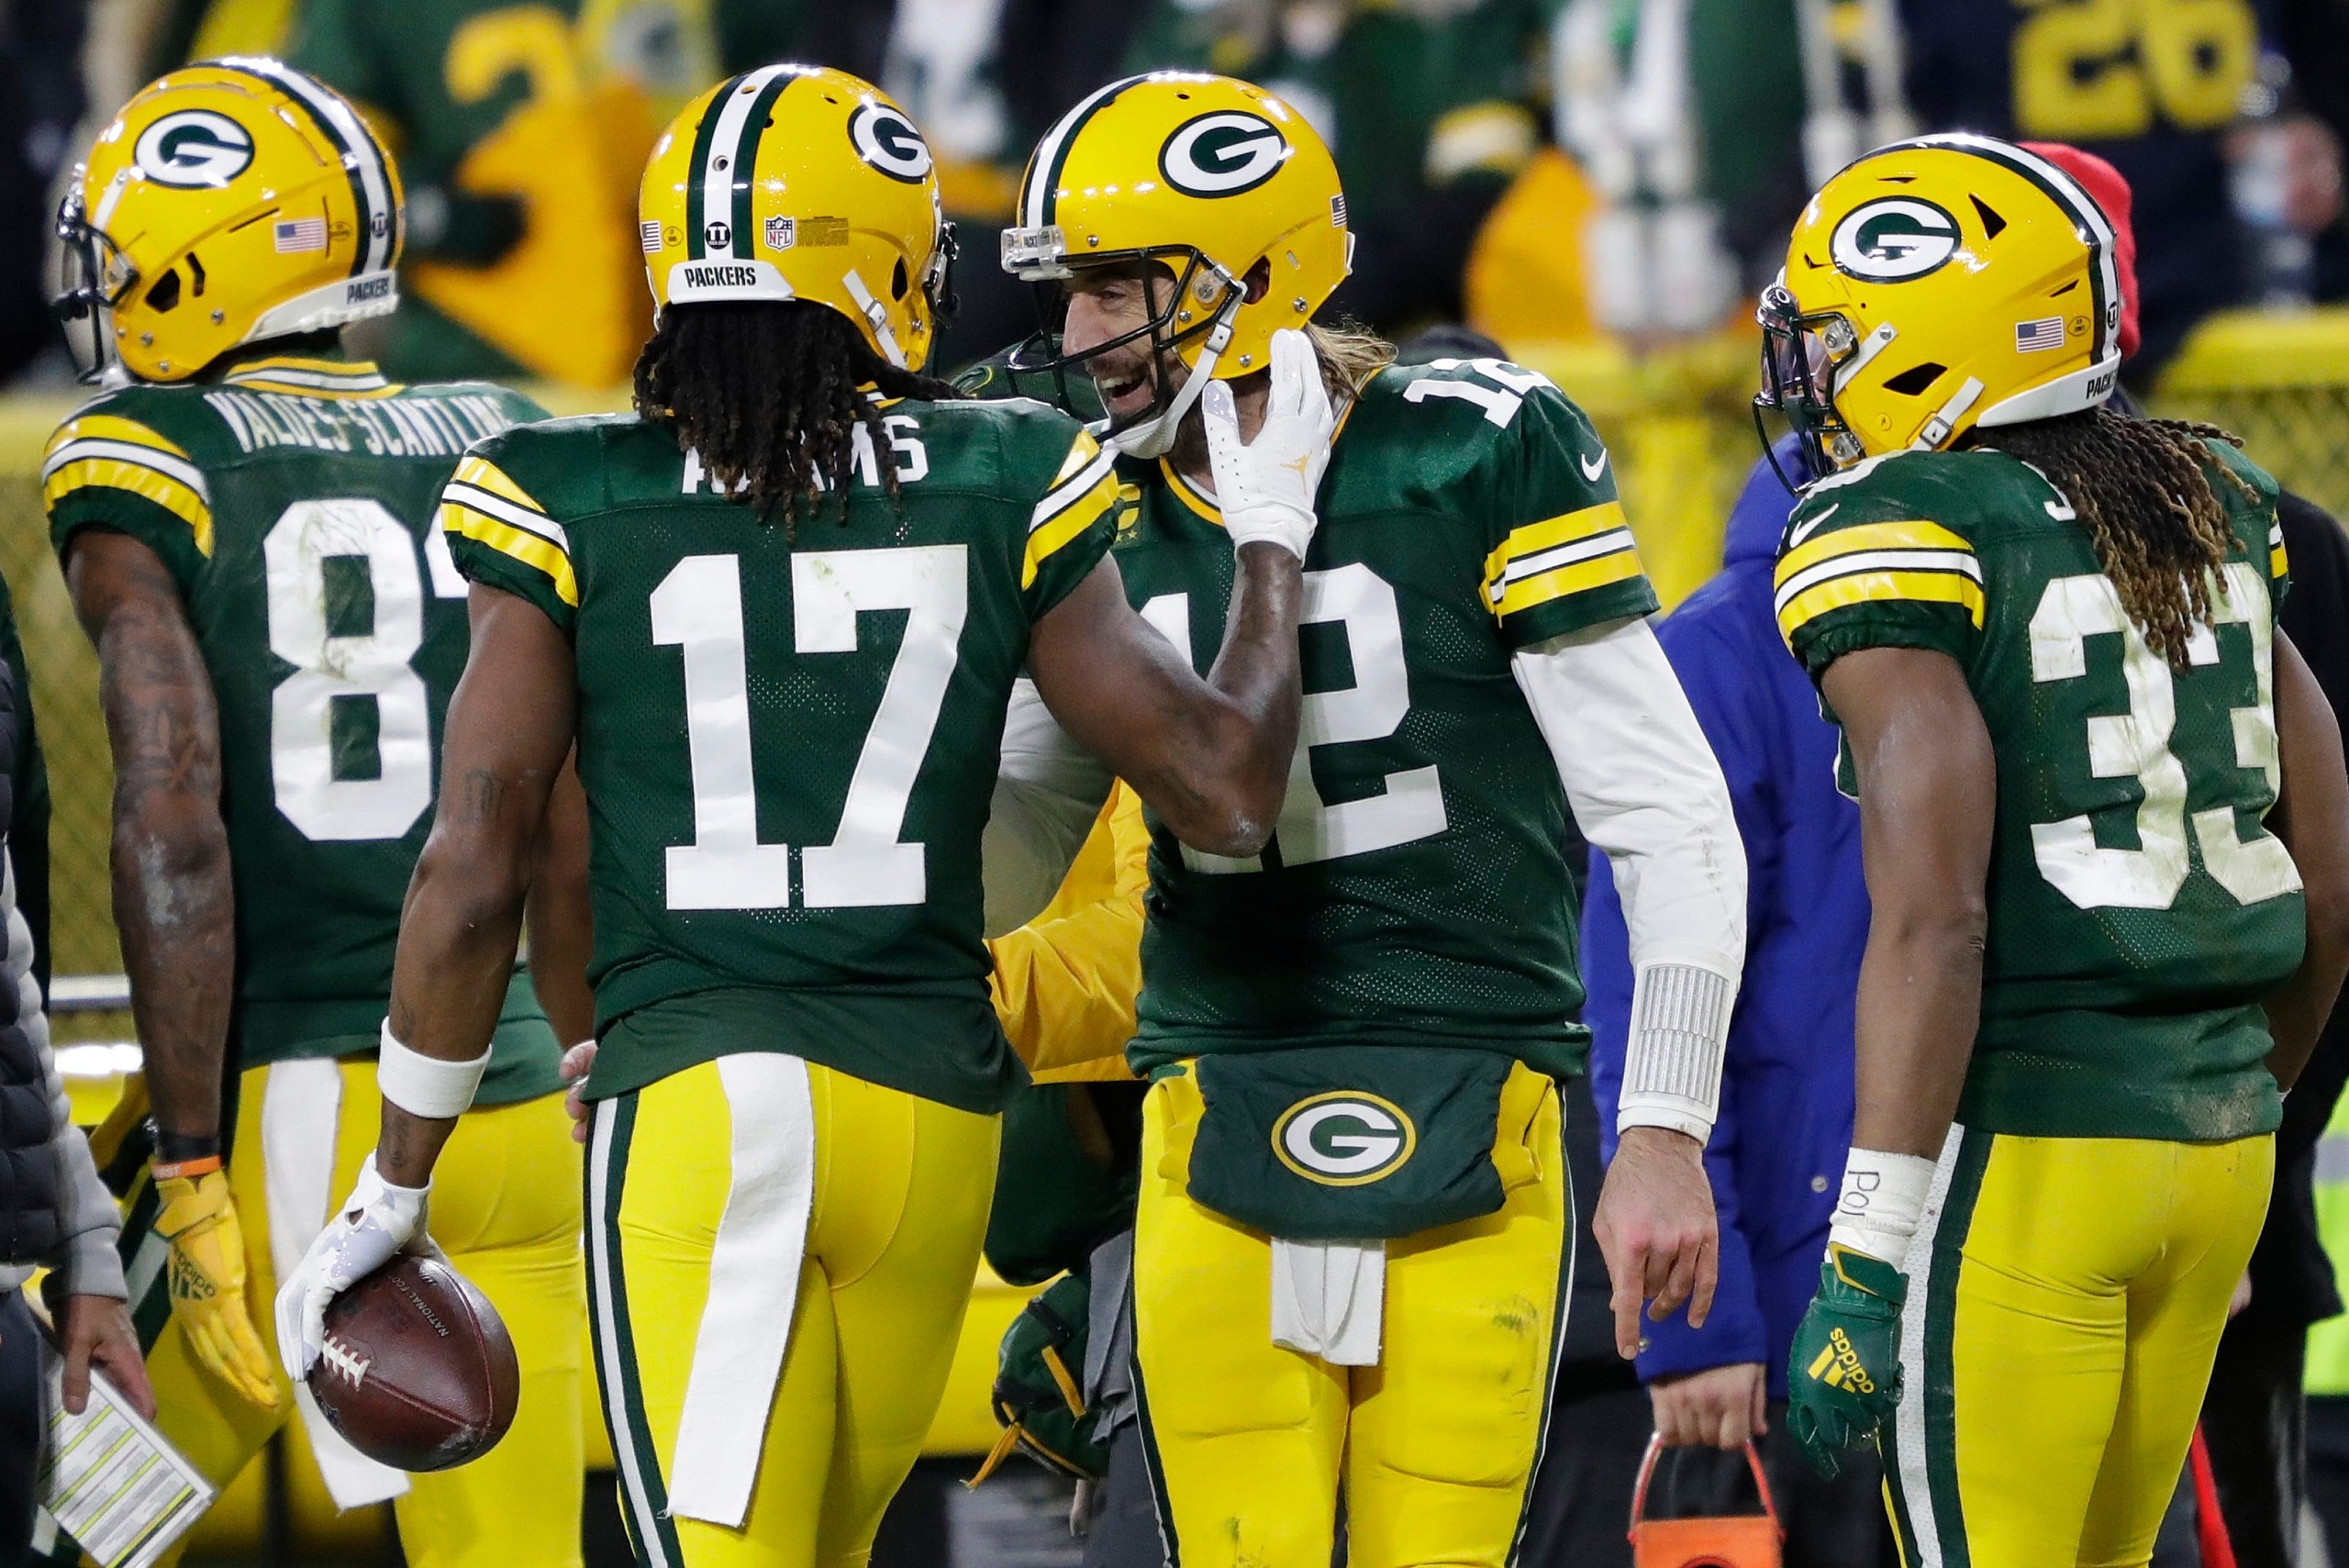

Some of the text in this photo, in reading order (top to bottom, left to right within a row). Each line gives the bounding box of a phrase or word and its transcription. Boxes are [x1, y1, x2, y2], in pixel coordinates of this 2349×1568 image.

[133, 108, 255, 190] G
[848, 103, 934, 183] G
[1158, 110, 1286, 199] G
[685, 266, 757, 288] PACKERS
[768, 230, 791, 244] NFL
[1830, 195, 1962, 284] G
[263, 498, 470, 841] 8
[650, 544, 968, 910] 17
[2029, 562, 2303, 909] 33
[1281, 1098, 1405, 1178] G
[409, 1292, 450, 1337] NATIONAL
[1830, 1327, 1876, 1395] adidas
